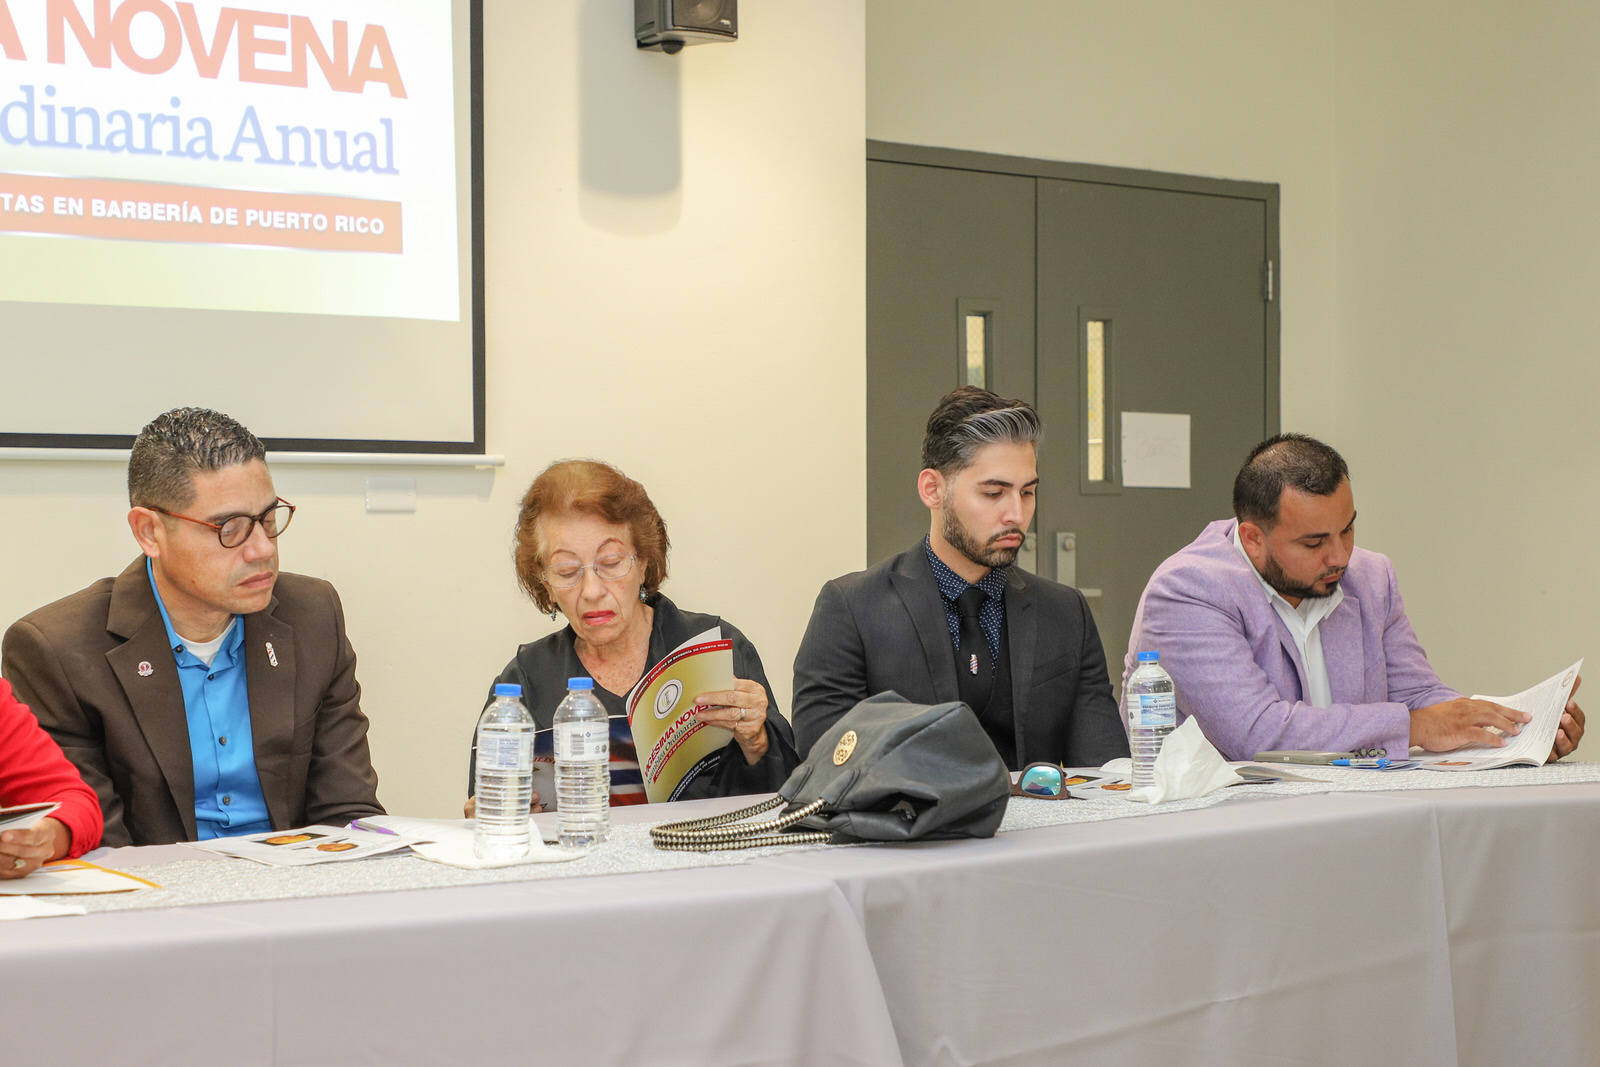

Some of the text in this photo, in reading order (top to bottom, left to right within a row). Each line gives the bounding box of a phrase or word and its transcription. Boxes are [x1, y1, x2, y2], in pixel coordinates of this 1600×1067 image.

[46, 0, 408, 99] NOVENA
[0, 85, 400, 176] dinaria Anual
[0, 193, 384, 236] TAS EN BARBERÍA DE PUERTO RICO
